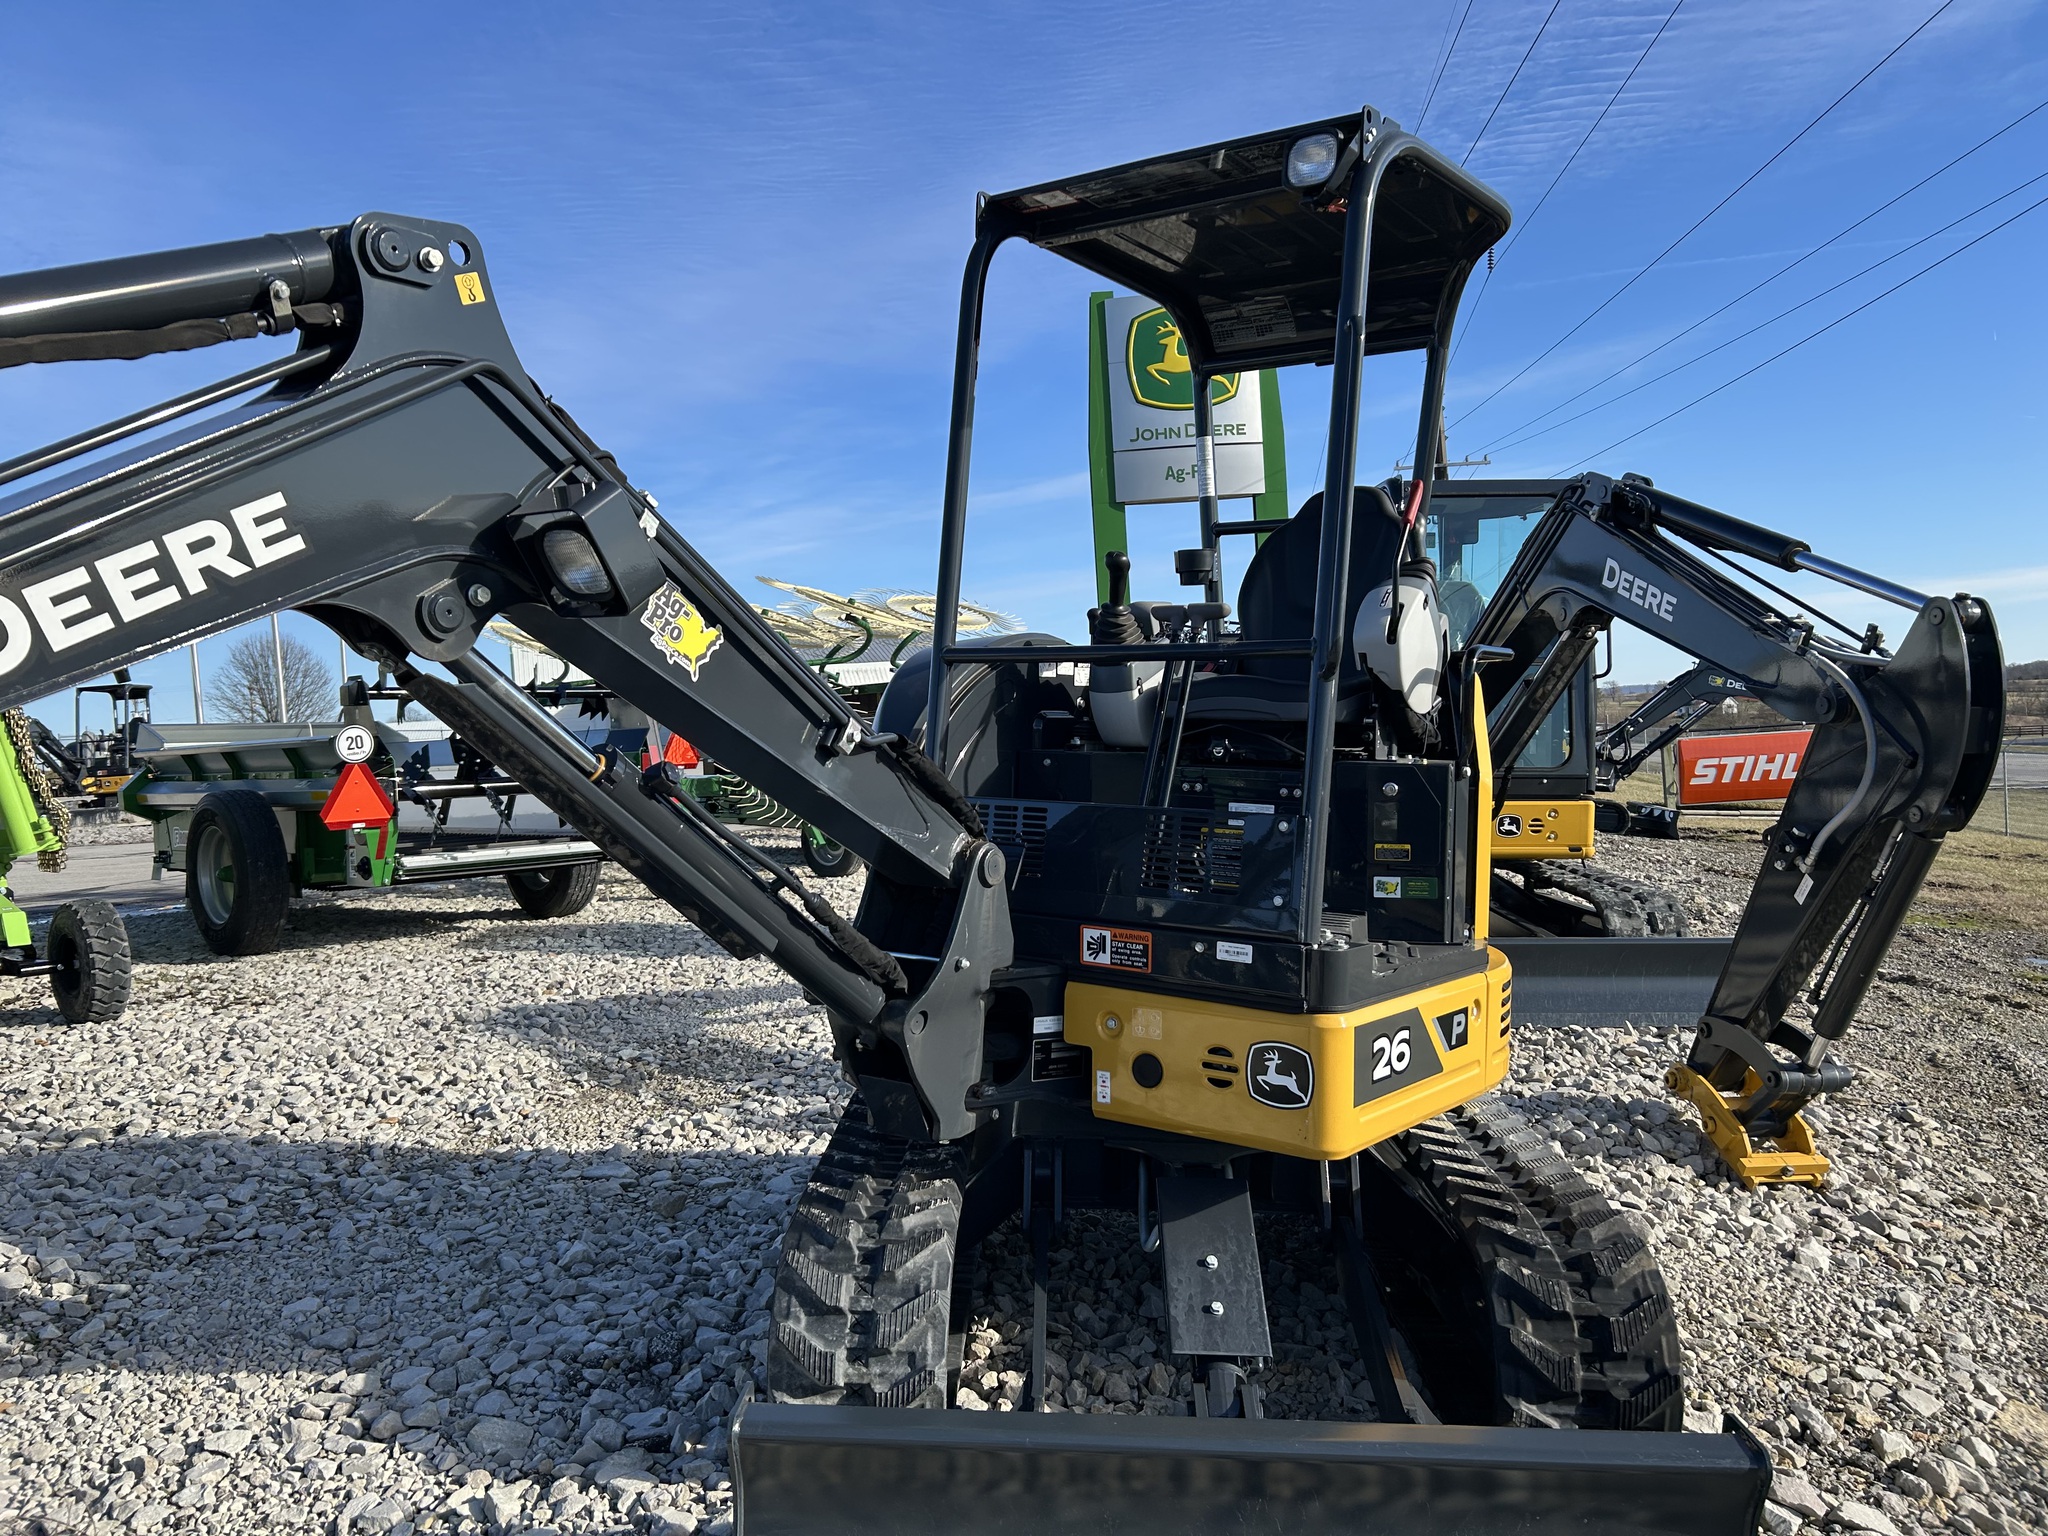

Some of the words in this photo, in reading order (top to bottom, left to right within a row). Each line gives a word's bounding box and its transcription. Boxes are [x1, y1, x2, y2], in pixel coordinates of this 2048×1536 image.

[1129, 427, 1181, 443] JOHN
[1184, 423, 1247, 438] DERE
[1165, 464, 1199, 483] Ag-P
[655, 582, 691, 620] Ag-
[1602, 557, 1678, 623] DEERE
[645, 600, 683, 641] Pro
[345, 735, 364, 751] 20
[1689, 752, 1798, 785] STIHL
[1118, 932, 1149, 942] WARNING
[1371, 1027, 1411, 1083] 26
[1451, 1013, 1466, 1045] P
